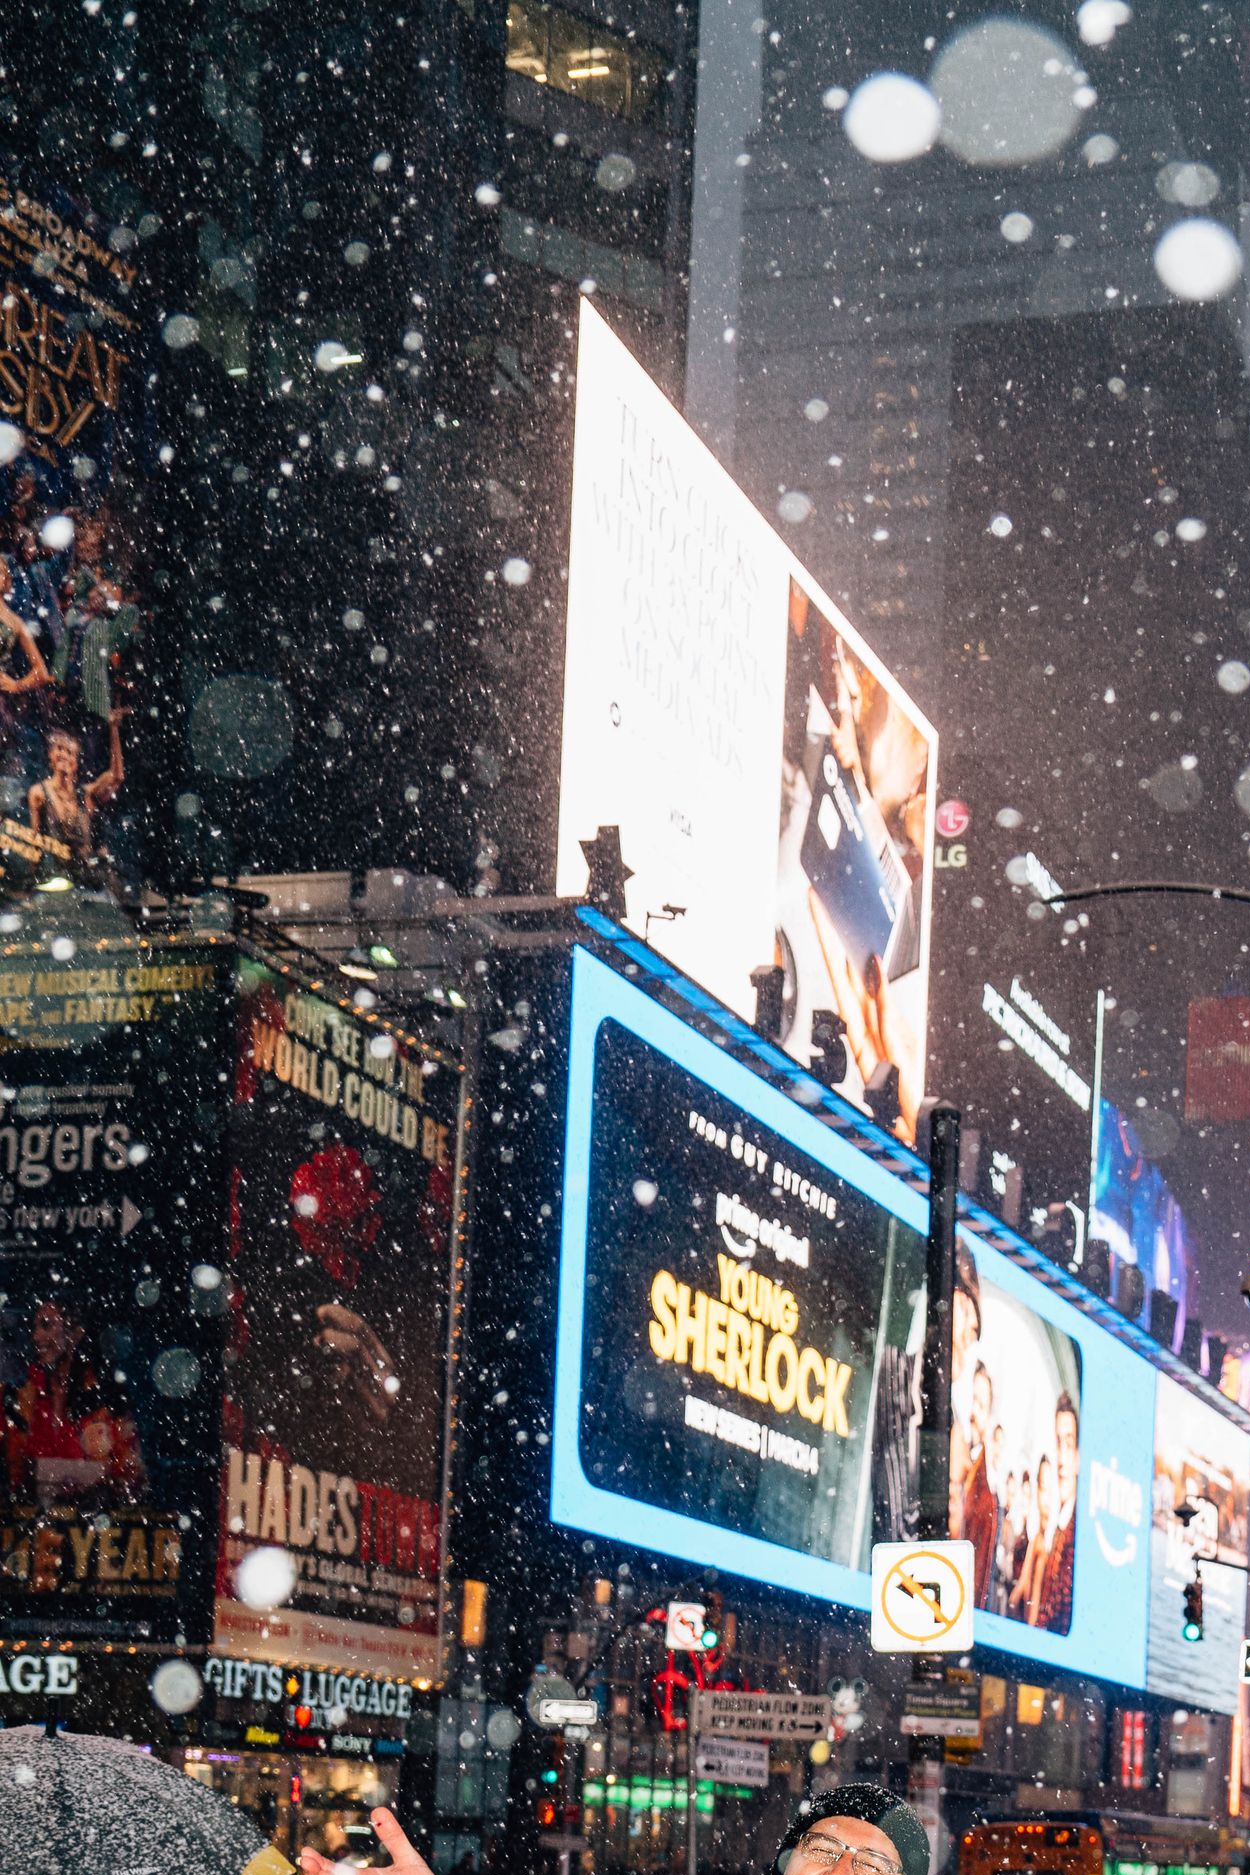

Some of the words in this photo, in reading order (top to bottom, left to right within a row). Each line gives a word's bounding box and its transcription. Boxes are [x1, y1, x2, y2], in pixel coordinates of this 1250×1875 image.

[934, 843, 968, 868] LG
[252, 1018, 339, 1107] WORLD
[343, 1072, 418, 1151] COULD
[13, 1206, 57, 1229] new
[66, 1203, 116, 1235] york
[772, 1160, 837, 1220] RITCHIE
[717, 1252, 800, 1337] YOUNG
[649, 1269, 852, 1438] SHERLOCK
[68, 1526, 181, 1581] YEAR
[204, 1657, 284, 1703] GIFTS
[302, 1669, 412, 1718] LUGGAGE
[331, 1735, 373, 1754] SONY
